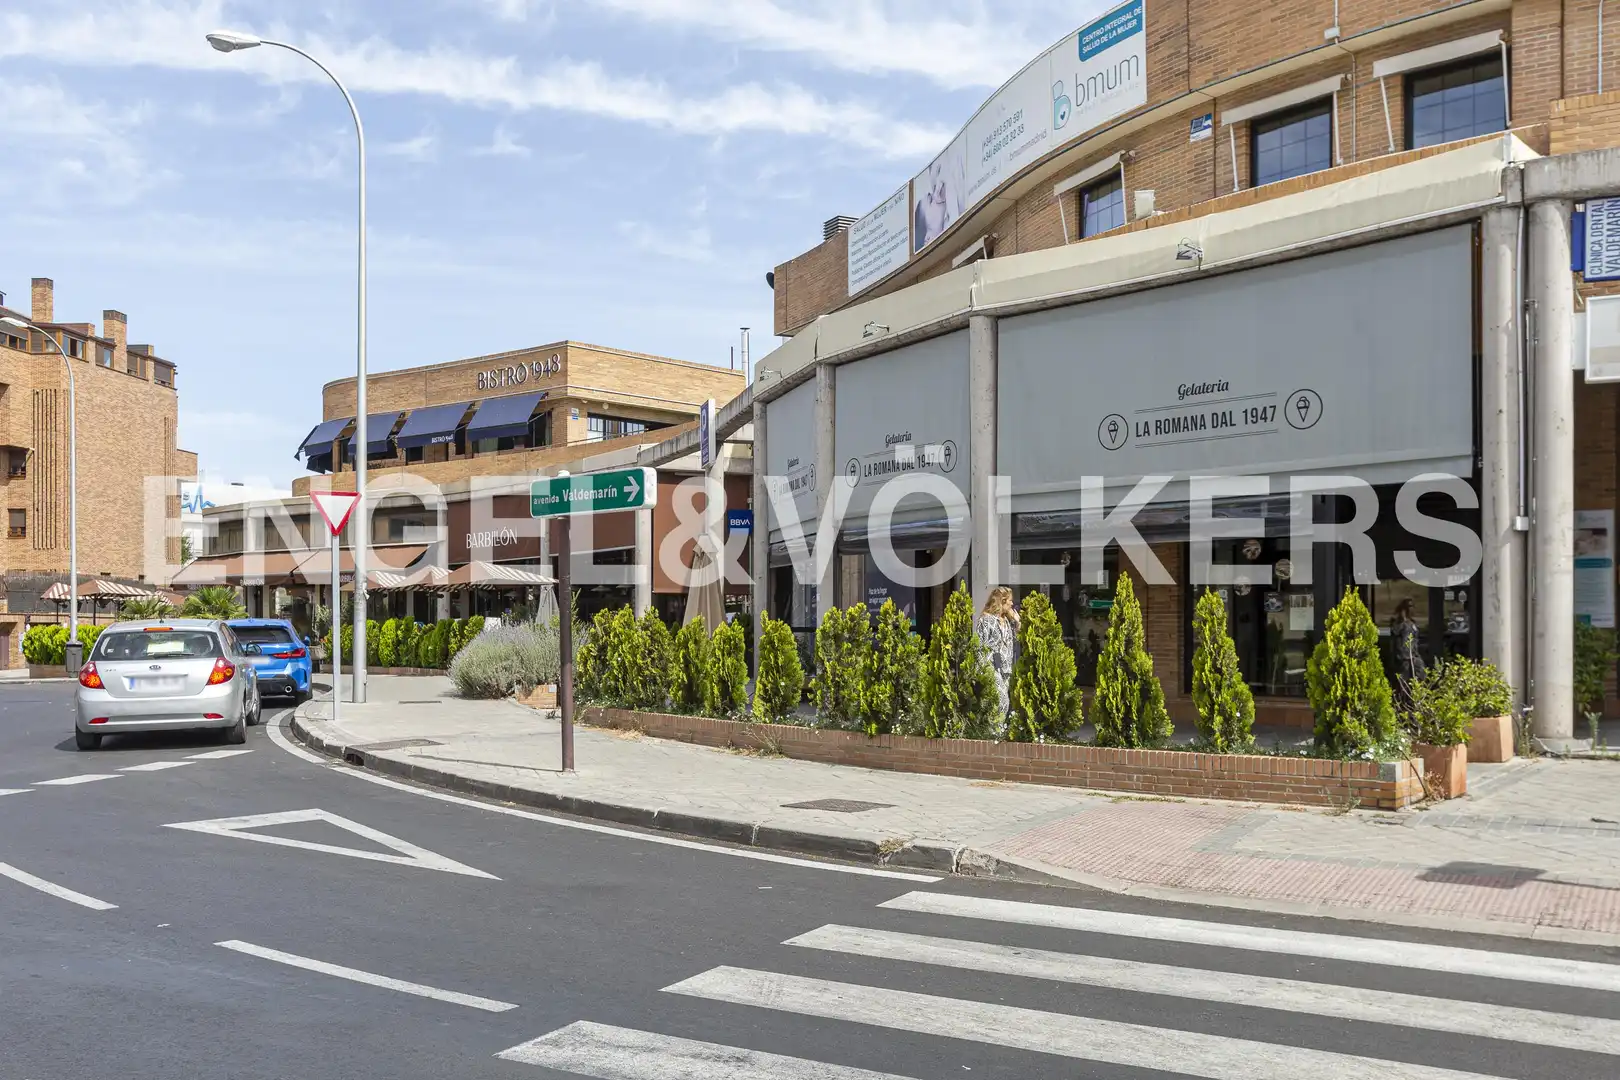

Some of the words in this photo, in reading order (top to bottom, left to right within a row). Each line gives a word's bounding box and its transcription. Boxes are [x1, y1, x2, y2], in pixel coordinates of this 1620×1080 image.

[1082, 27, 1105, 45] CENTRO
[1104, 12, 1134, 33] INTEGRAL
[1133, 6, 1142, 17] DE
[1082, 40, 1100, 54] SALUD
[1100, 35, 1109, 44] DE
[1109, 30, 1117, 39] LA
[1117, 19, 1138, 35] MUJER
[1075, 54, 1139, 107] bmum
[1590, 201, 1605, 238] DENTAL
[1588, 238, 1604, 276] CLÍNICA
[529, 353, 561, 381] 1948
[1177, 379, 1229, 401] Gelateria
[1135, 421, 1151, 438] LA
[1155, 415, 1207, 436] ROMANA
[1211, 410, 1237, 429] DAL
[1242, 404, 1278, 425] 1947
[884, 431, 912, 448] Gelateria
[864, 463, 872, 478] LA
[873, 458, 901, 477] ROMANA
[901, 456, 915, 472] DAL
[917, 453, 936, 470] 1947
[533, 494, 560, 505] avenida
[562, 485, 618, 503] Valdemarín
[730, 518, 751, 527] BBVA
